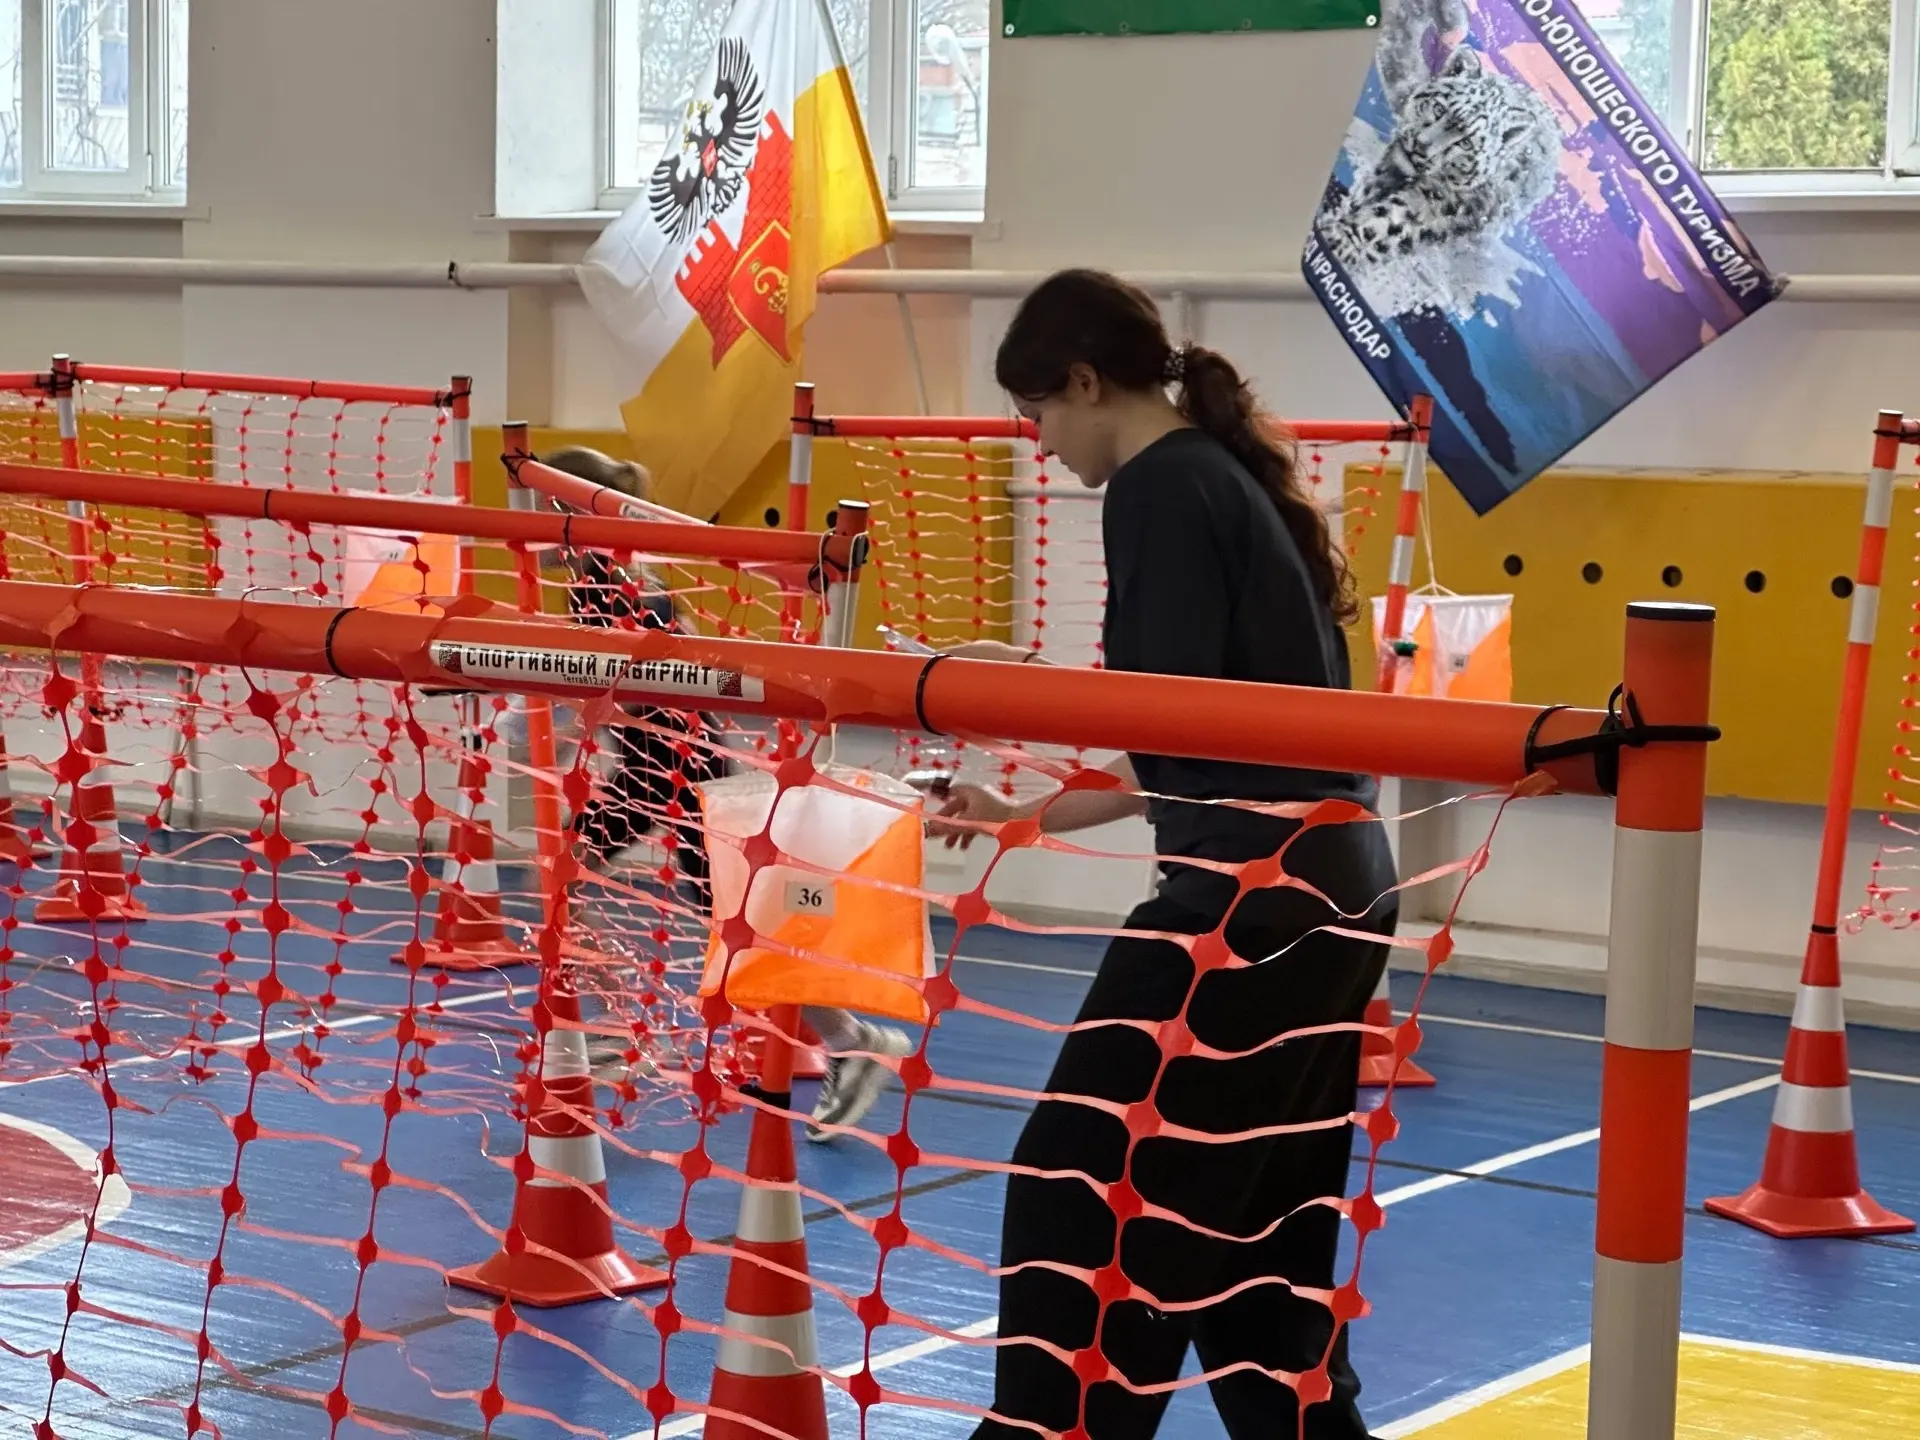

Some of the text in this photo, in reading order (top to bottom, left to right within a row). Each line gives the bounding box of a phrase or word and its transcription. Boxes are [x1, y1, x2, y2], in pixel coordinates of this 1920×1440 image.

[1520, 0, 1760, 297] О-ЮНОШЕСКОГО ТУРИЗМА
[1310, 251, 1391, 359] КРАСНОДАР
[466, 647, 712, 686] СПОРТИВНЫЙ ЛАБИРИНТ
[562, 673, 610, 687] Terra812.ru
[797, 887, 823, 907] 36
